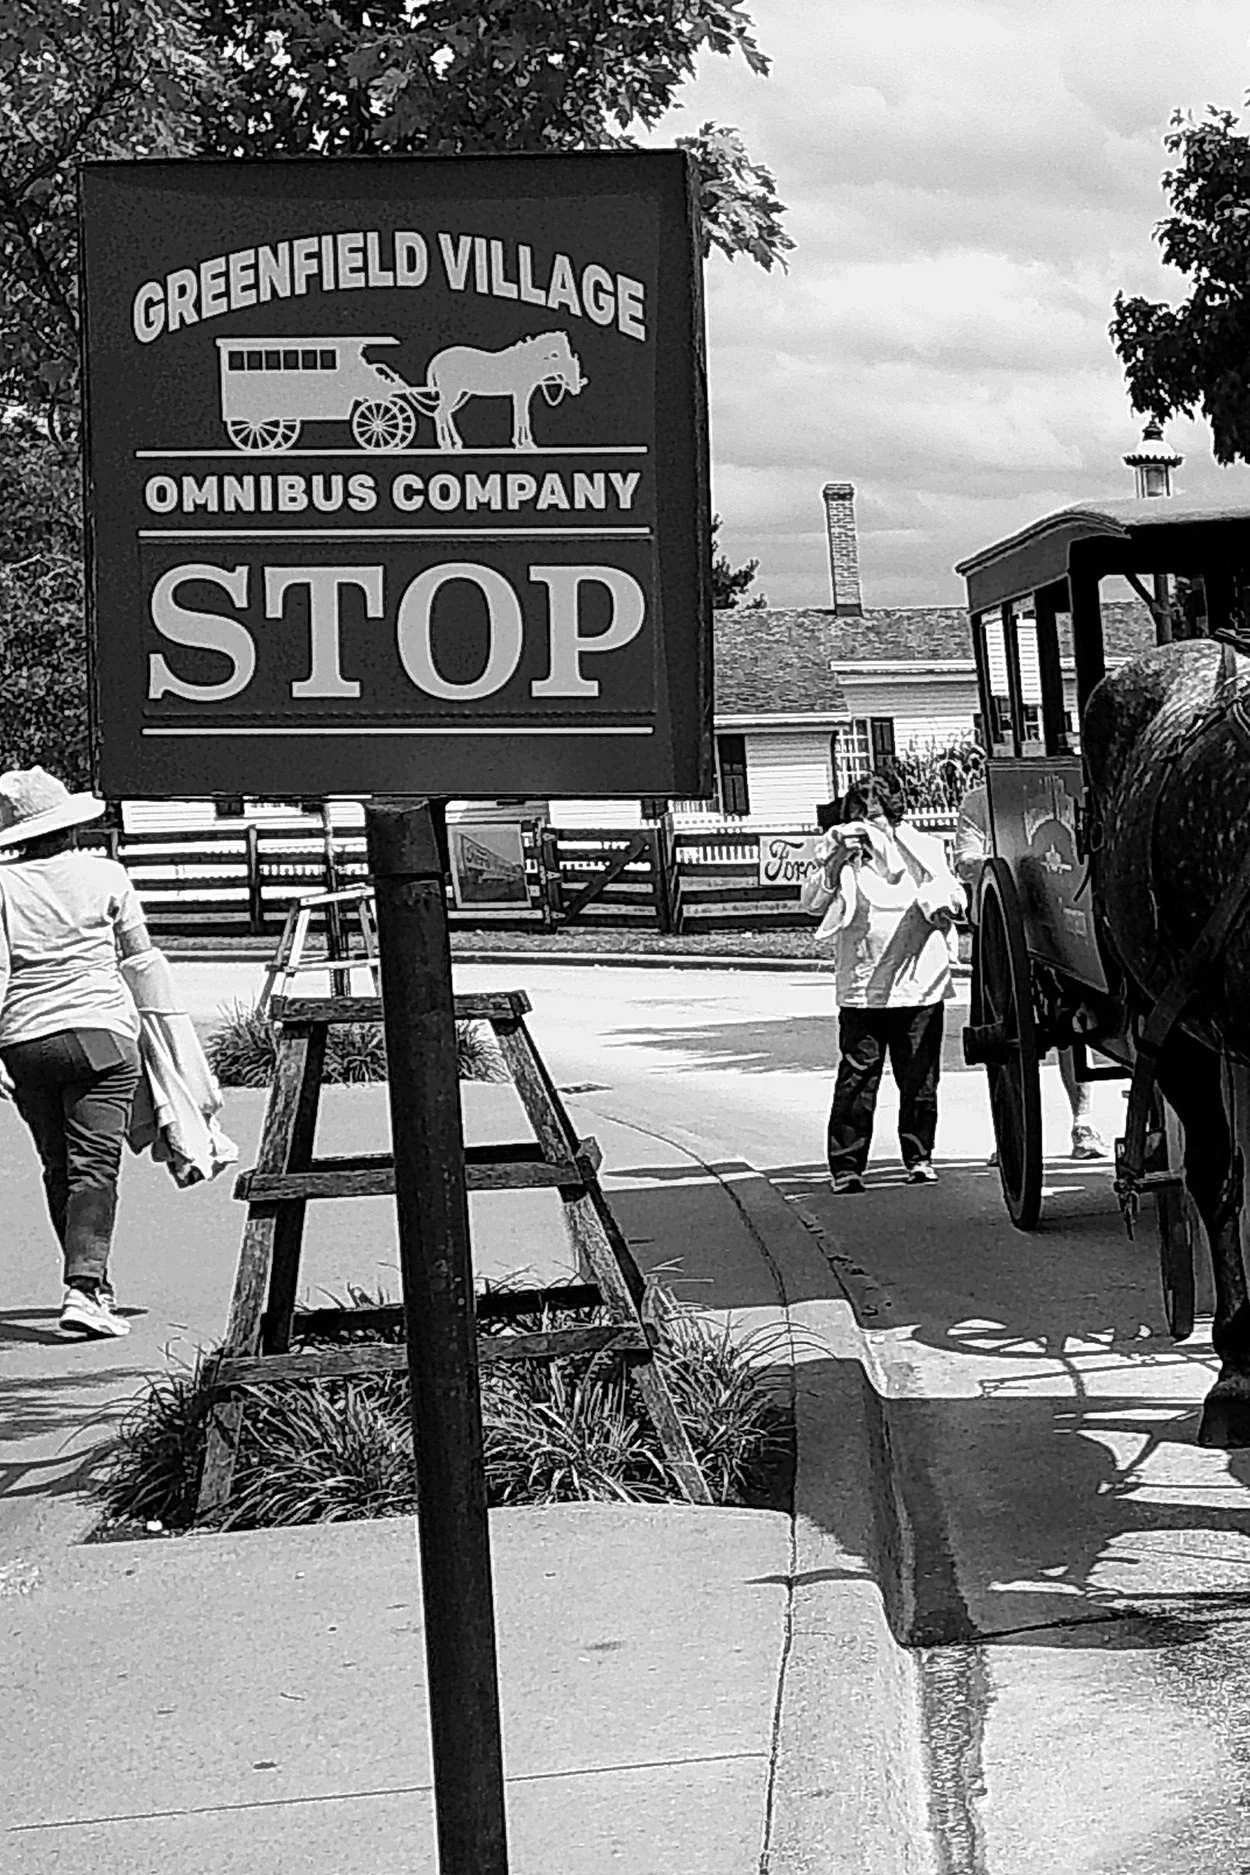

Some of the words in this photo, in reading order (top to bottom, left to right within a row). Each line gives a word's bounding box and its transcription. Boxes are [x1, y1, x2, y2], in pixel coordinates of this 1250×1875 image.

[133, 231, 428, 343] GREENFIELD
[438, 232, 646, 342] VILLAGE
[145, 474, 378, 513] OMNIBUS
[391, 472, 642, 512] COMPANY
[148, 562, 647, 702] STOP
